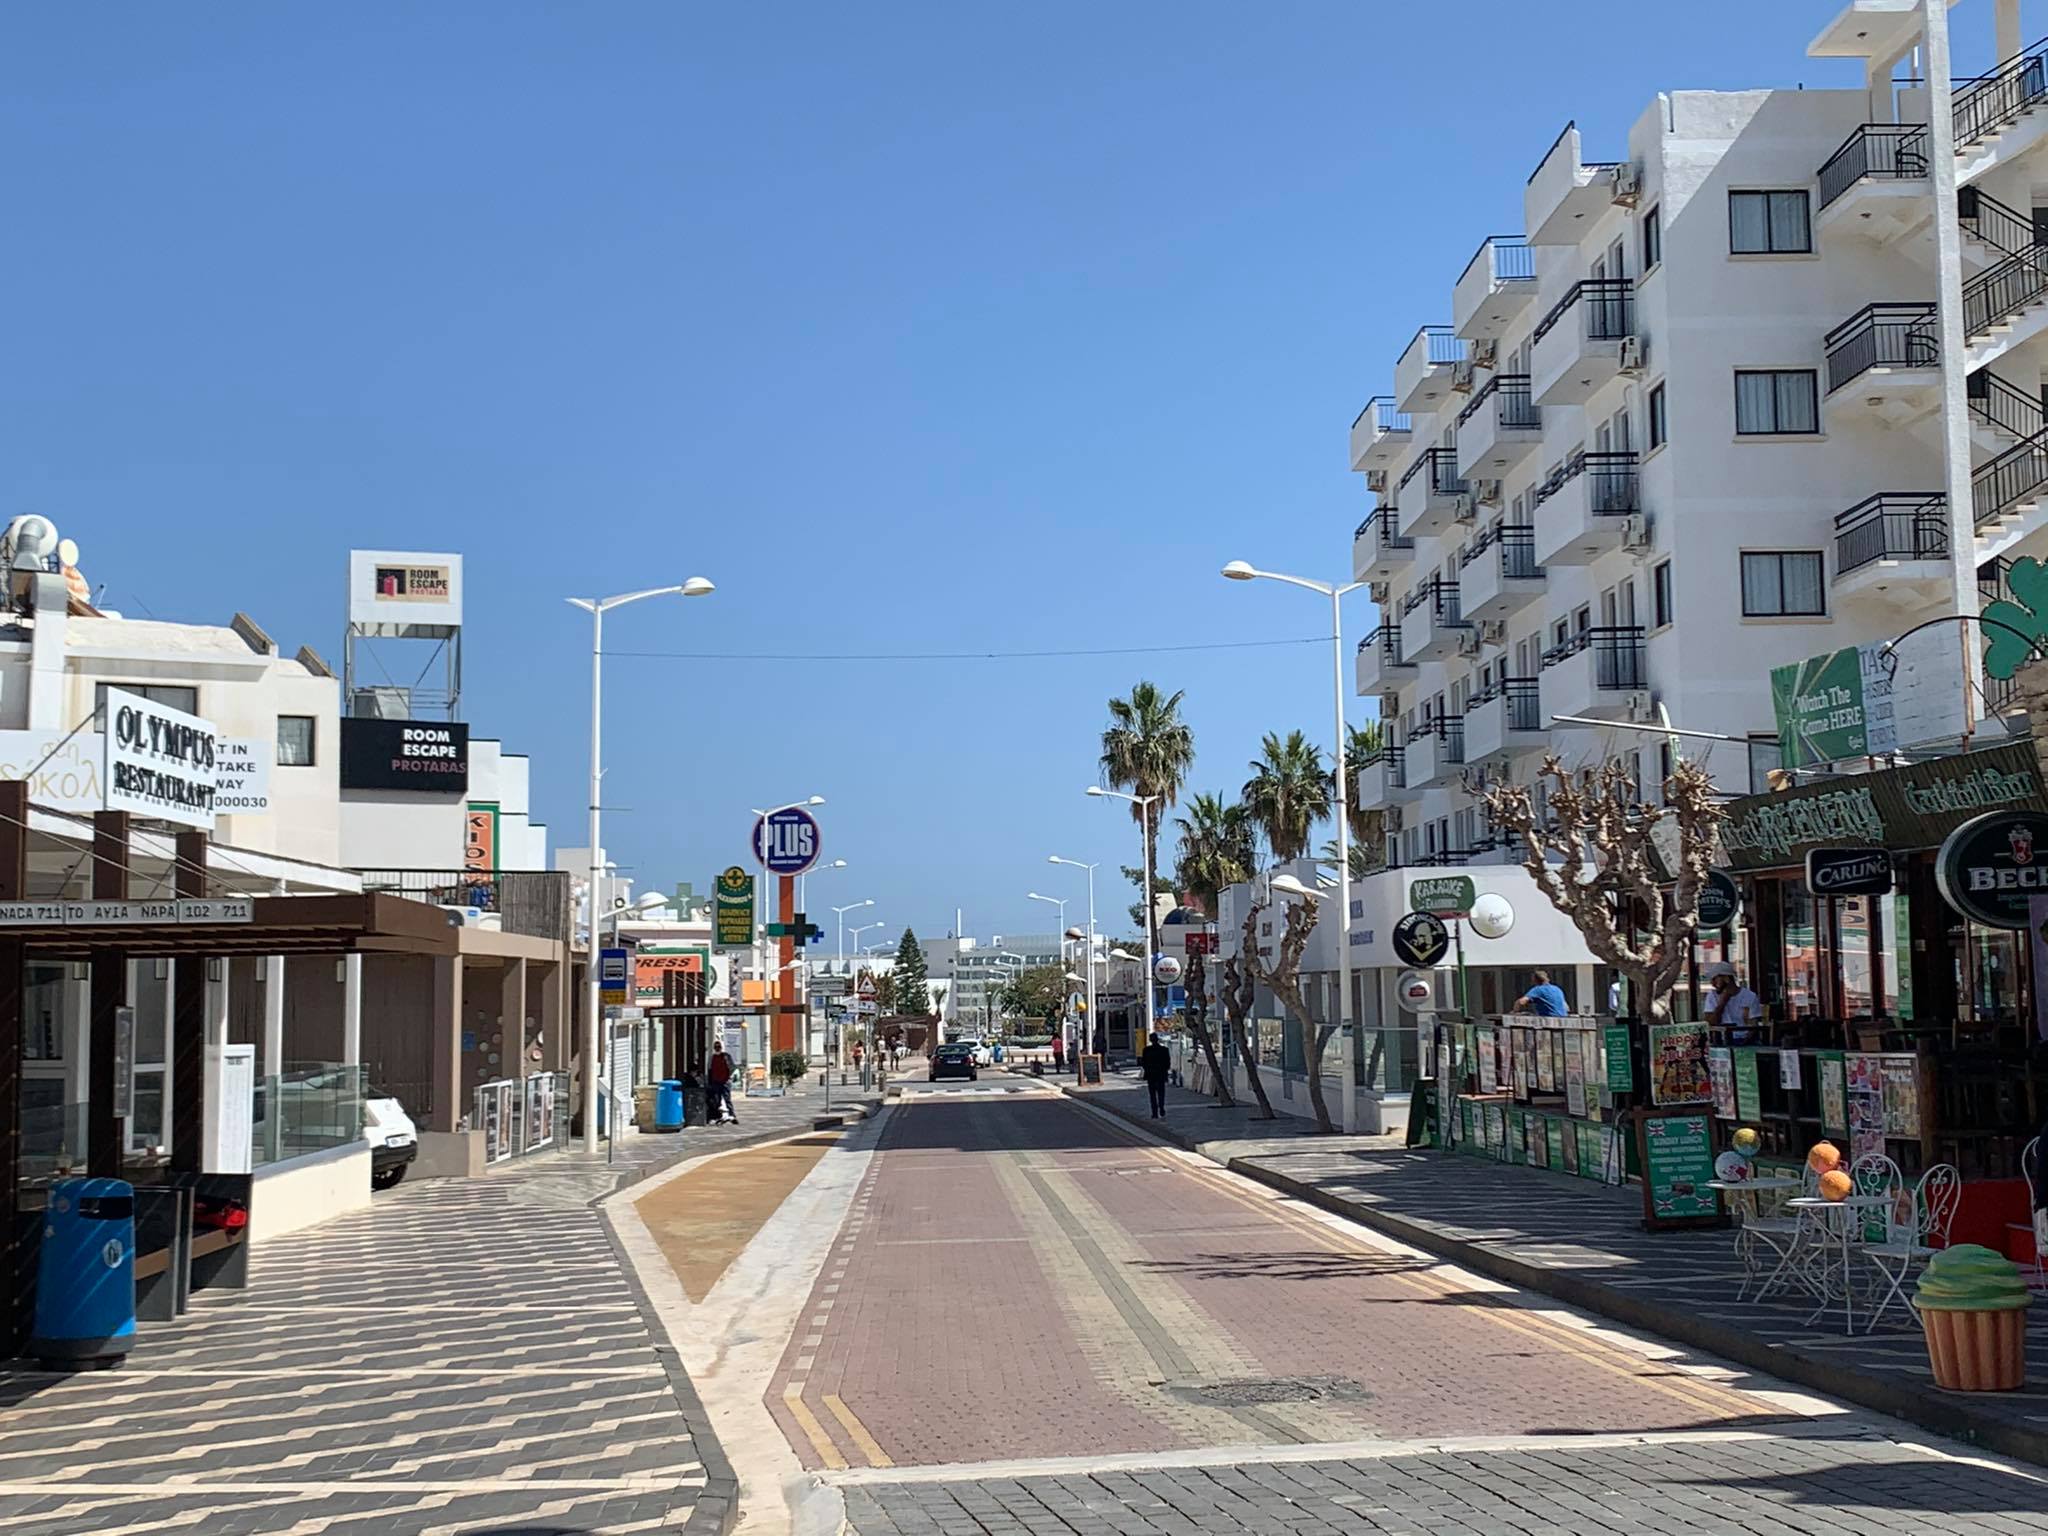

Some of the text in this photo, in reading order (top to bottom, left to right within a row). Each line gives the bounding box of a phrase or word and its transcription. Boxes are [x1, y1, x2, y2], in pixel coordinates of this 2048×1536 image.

[410, 569, 439, 579] ROOM
[410, 580, 449, 589] ESCAPE
[1829, 685, 1851, 706] The
[1829, 706, 1862, 730] HERE
[116, 705, 215, 770] OLYMPUS
[403, 729, 450, 742] ROOM
[232, 744, 248, 755] IN
[403, 744, 457, 758] ESCAPE
[216, 761, 256, 773] TAKE
[391, 759, 467, 774] PROTARAS
[113, 761, 216, 811] RESTAURANT
[758, 823, 813, 857] PLUS
[1815, 859, 1888, 886] CARLING
[1414, 880, 1464, 900] KARAOKE
[1700, 888, 1724, 897] OHN
[38, 906, 62, 919] 711
[67, 906, 83, 919] TO
[94, 906, 129, 918] AYIA
[141, 905, 176, 918] NAPA
[185, 905, 210, 918] 102
[223, 905, 248, 918] 711
